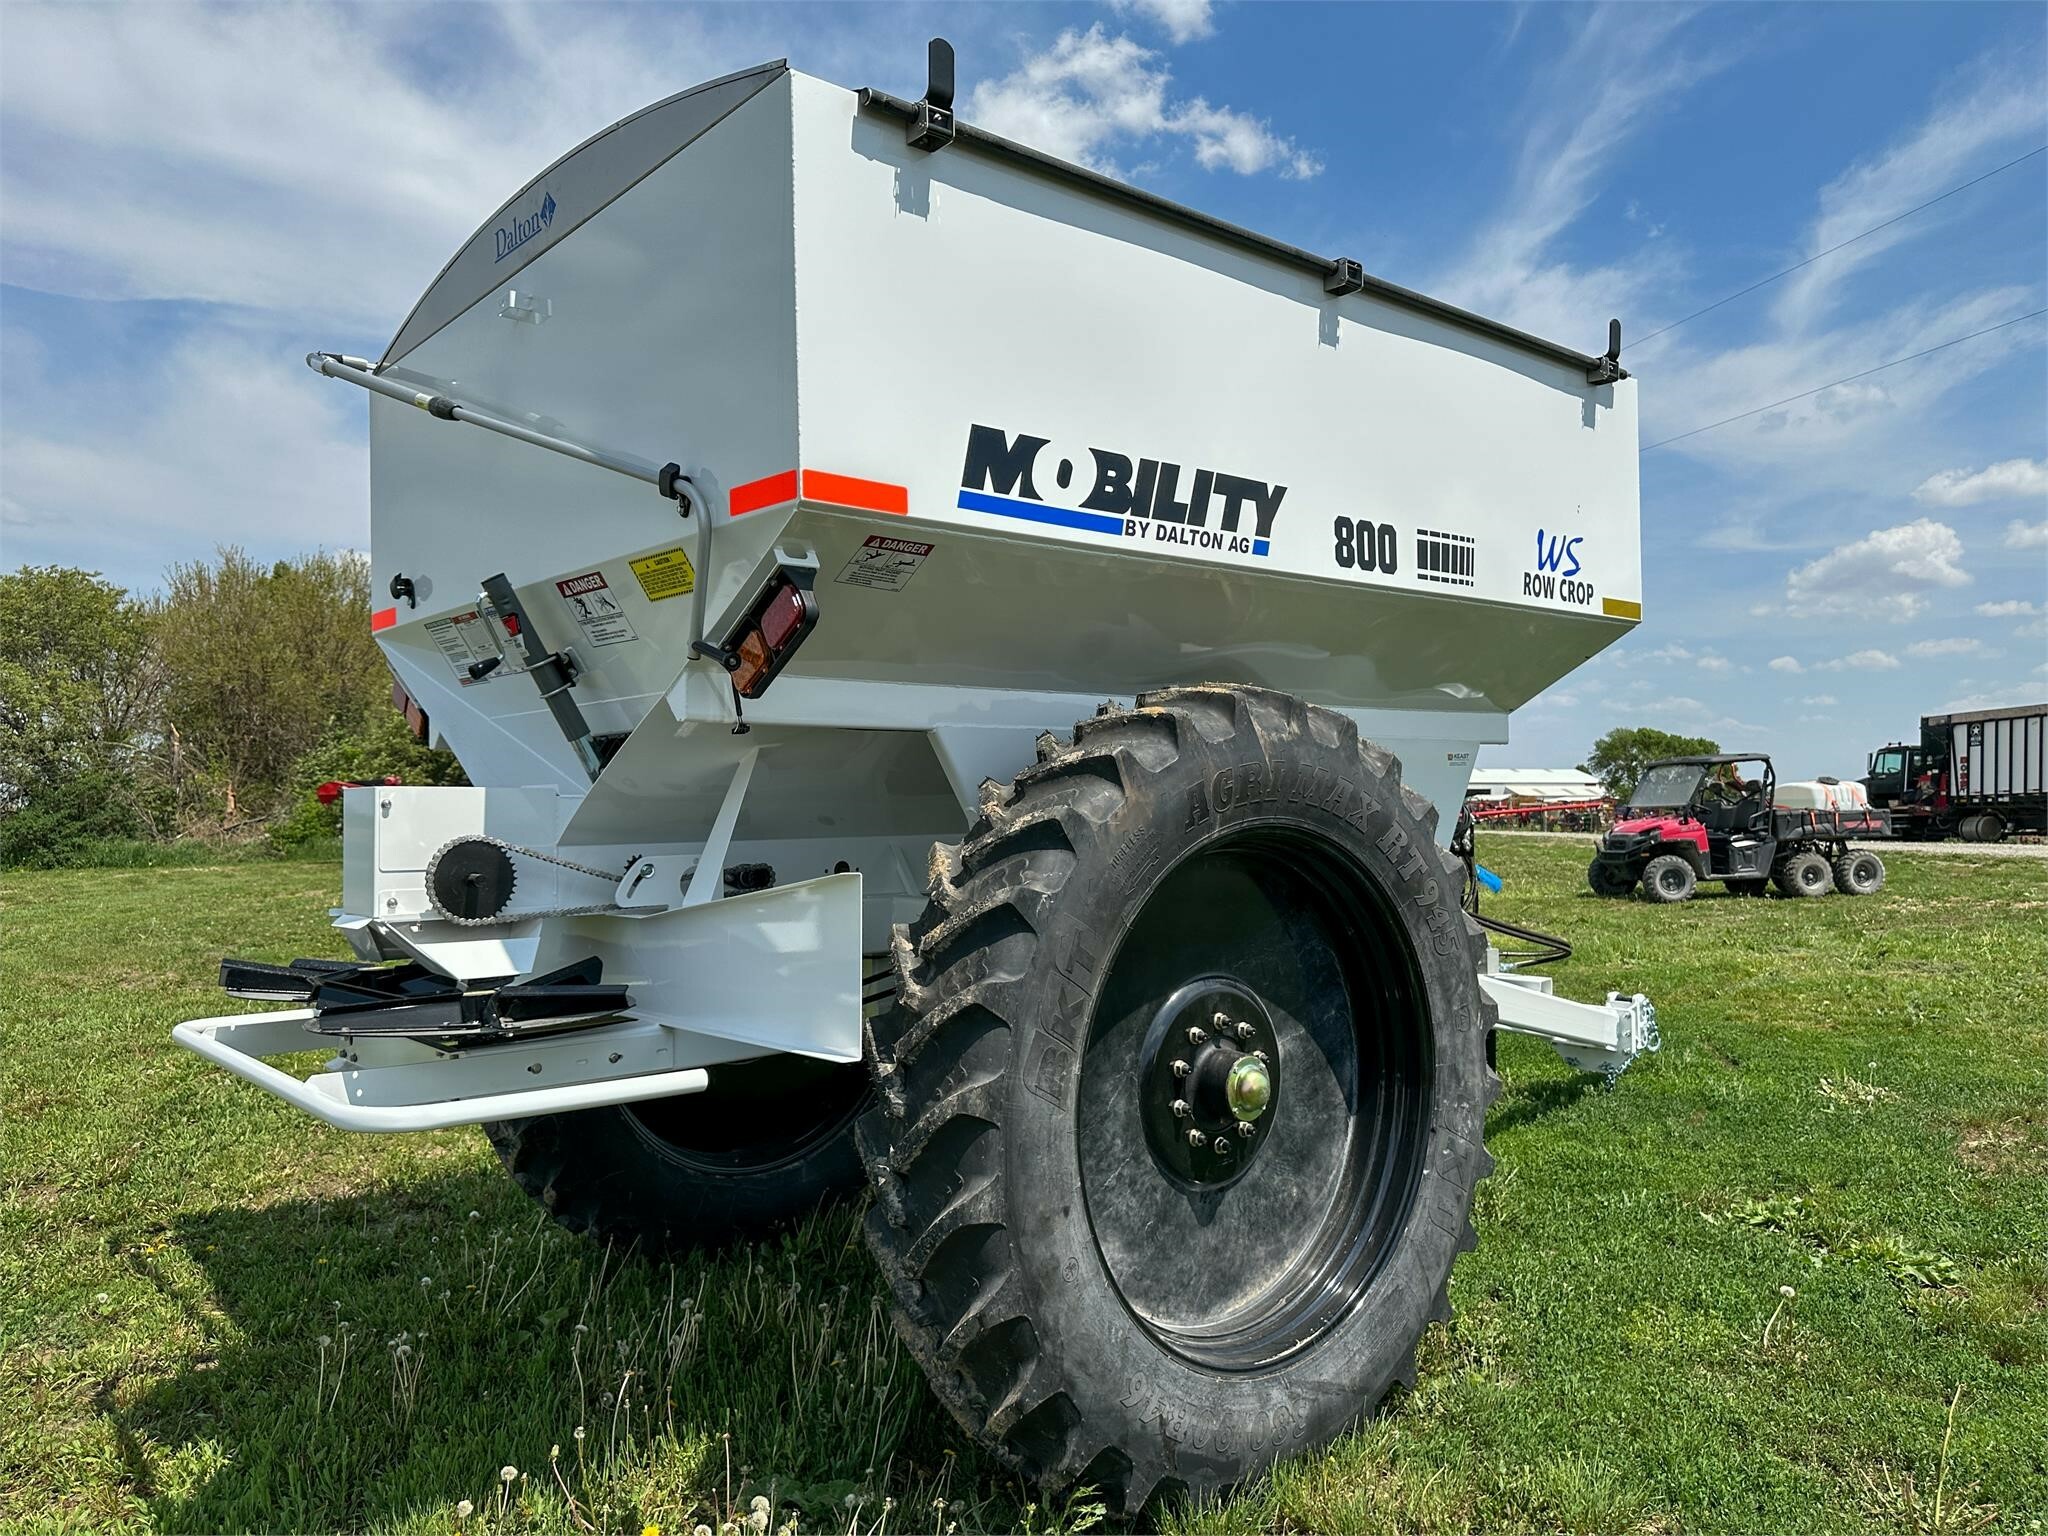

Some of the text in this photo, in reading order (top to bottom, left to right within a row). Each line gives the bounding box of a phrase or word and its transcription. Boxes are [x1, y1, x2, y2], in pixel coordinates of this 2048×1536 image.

[493, 211, 541, 258] Dalton
[960, 423, 1288, 539] MOBILITY
[881, 538, 929, 555] DANGER
[1124, 519, 1250, 554] BY DALTON AG
[1333, 515, 1398, 576] 800
[1537, 528, 1584, 577] WS
[568, 574, 604, 593] DANGER
[1522, 571, 1595, 606] ROW CROP
[1375, 817, 1429, 882] RT
[1413, 876, 1461, 957] 945
